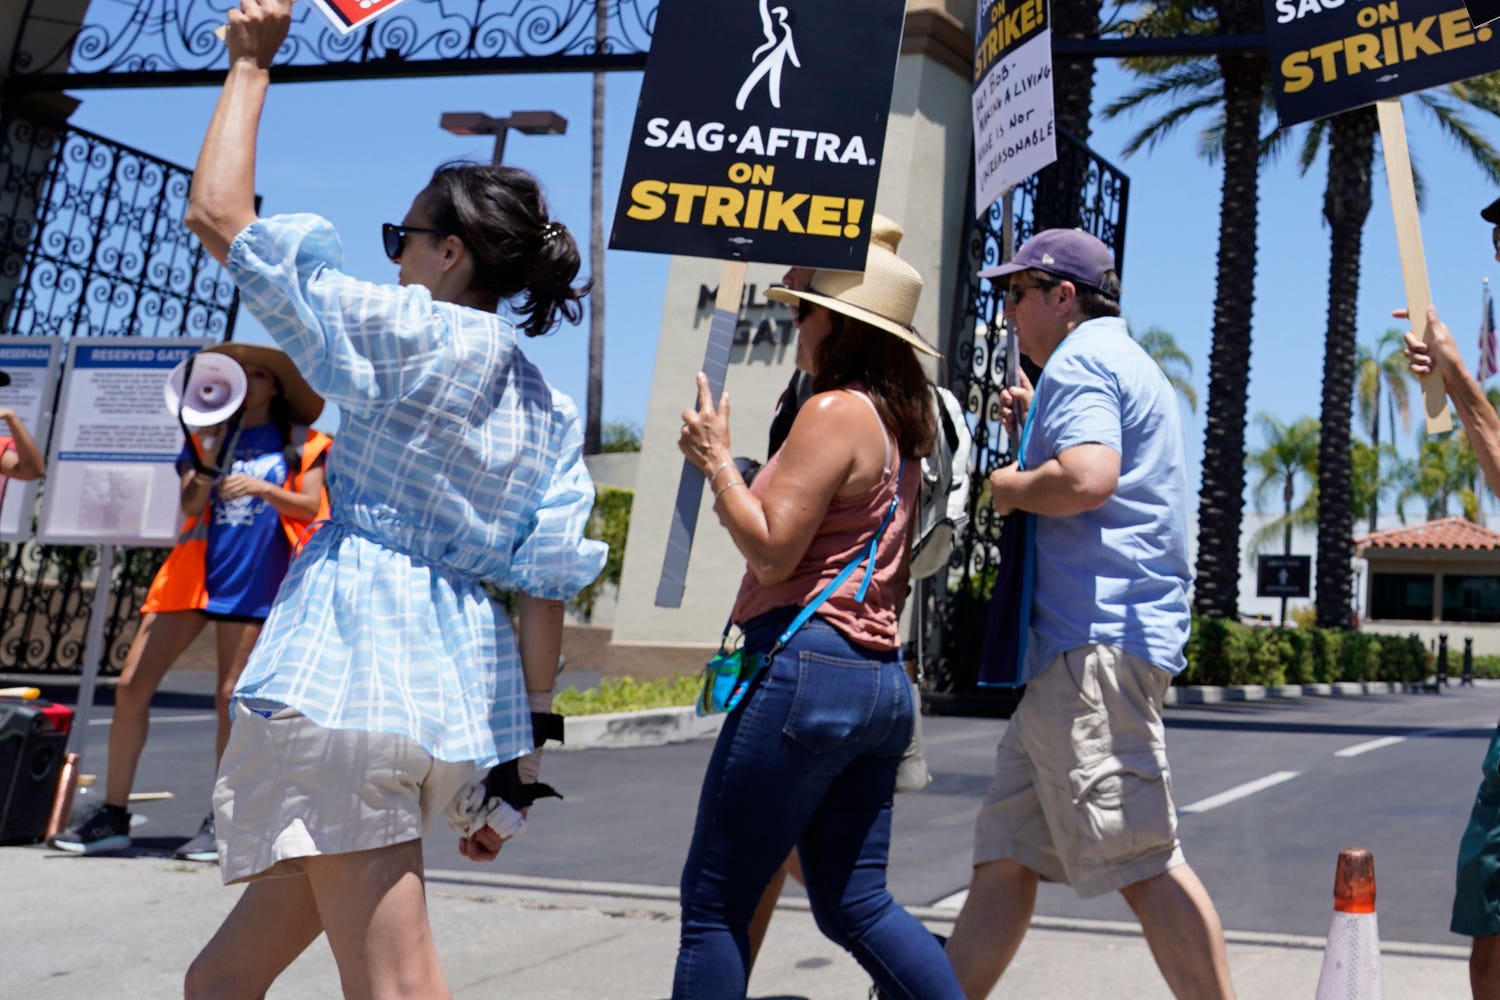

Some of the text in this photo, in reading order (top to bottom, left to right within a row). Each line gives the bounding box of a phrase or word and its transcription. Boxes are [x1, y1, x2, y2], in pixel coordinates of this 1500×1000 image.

[1356, 0, 1399, 29] ON
[1014, 64, 1051, 97] LIVING
[1009, 108, 1035, 130] NOT
[980, 120, 1053, 192] UNREASONABLE
[728, 162, 775, 186] ON
[626, 180, 865, 239] STRIKE!
[733, 319, 794, 346] GAT
[91, 348, 190, 361] RESERVED GATE
